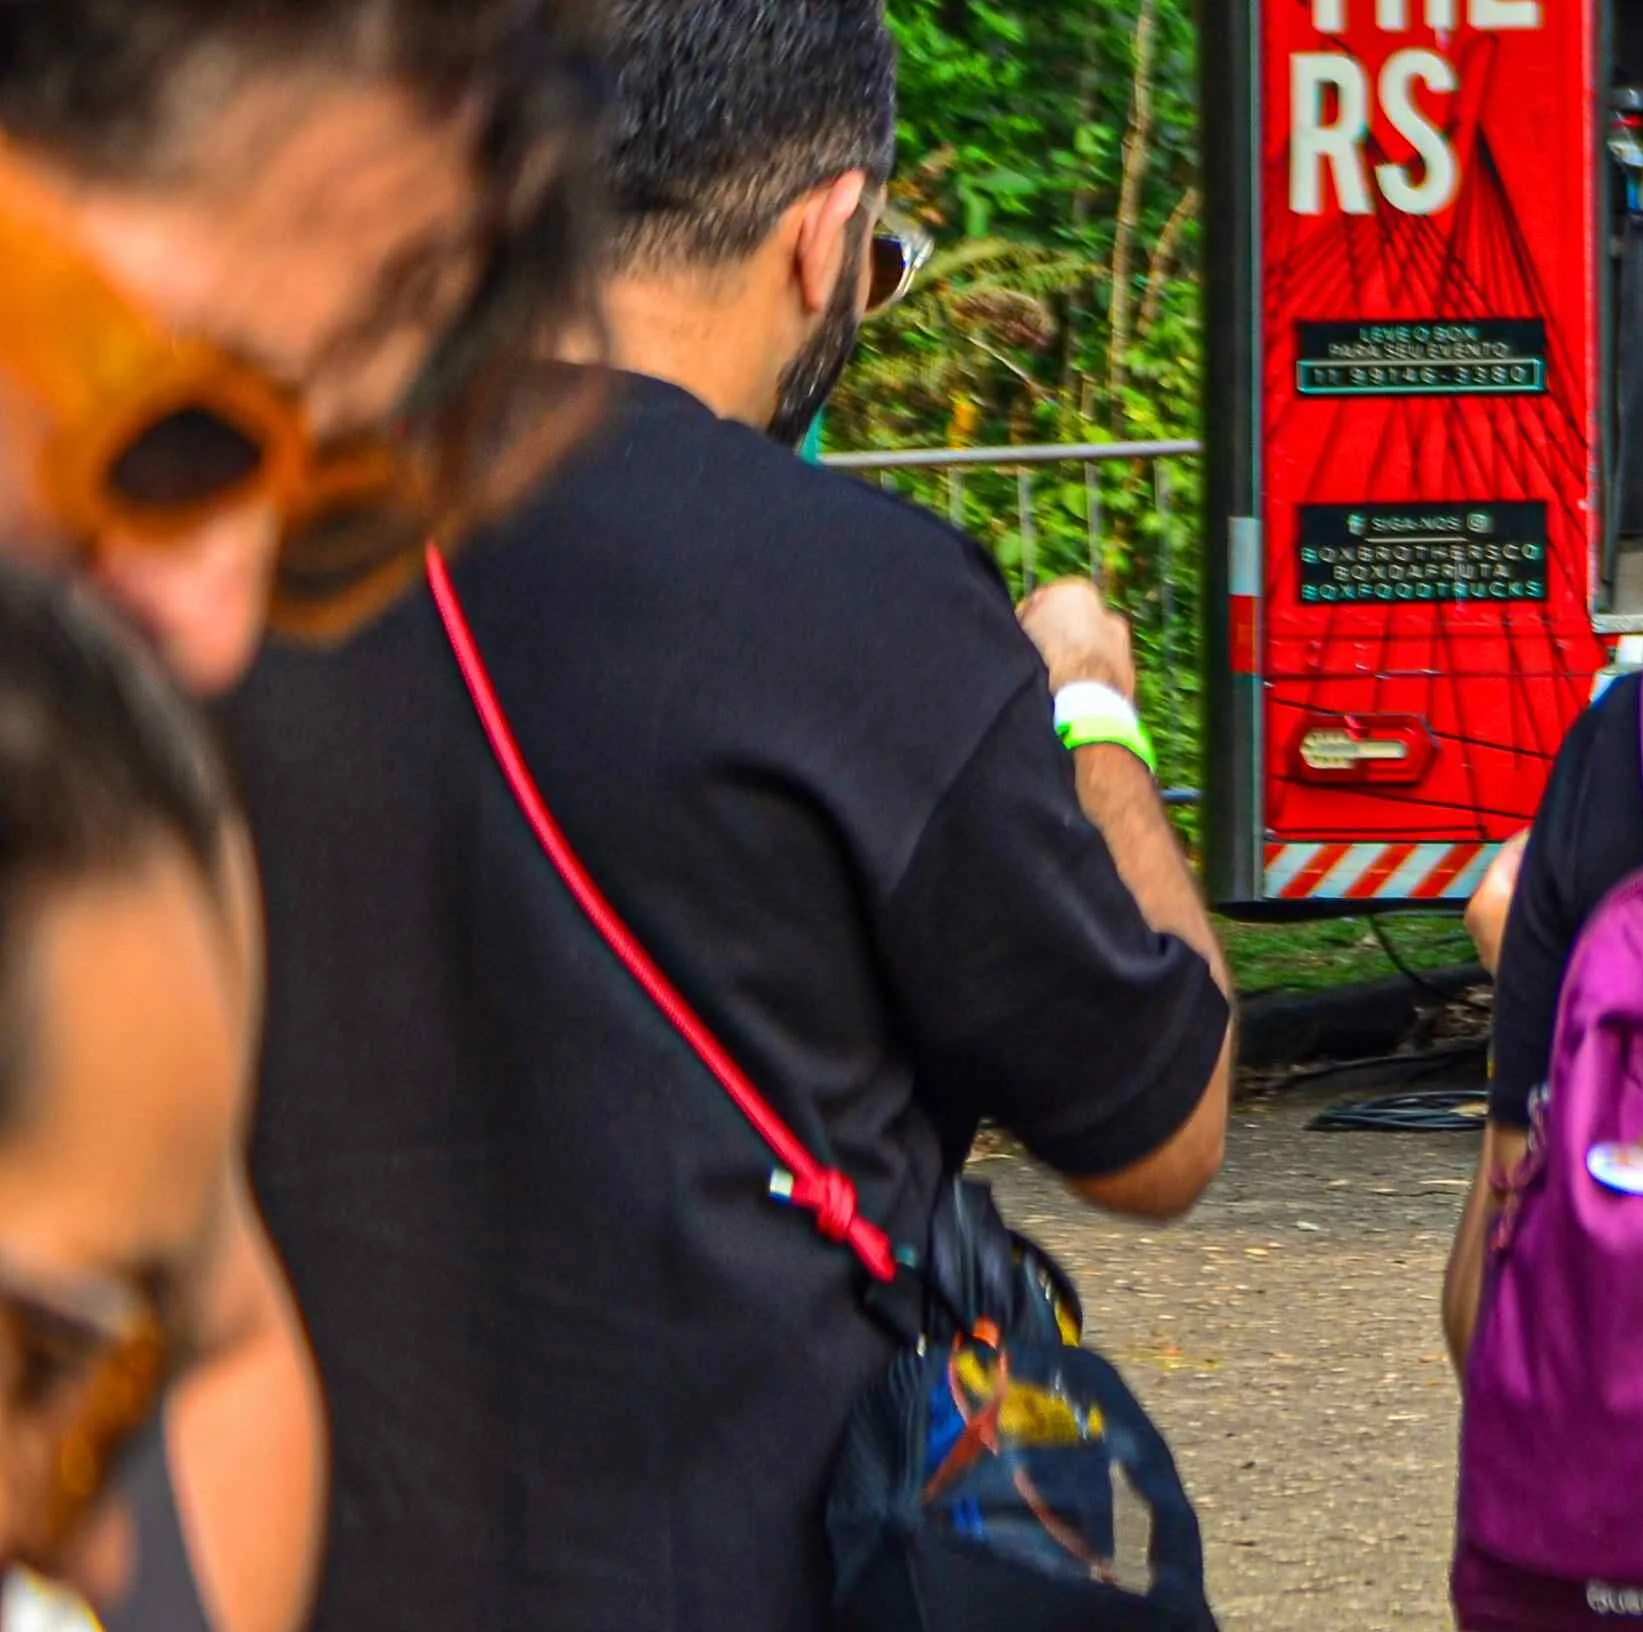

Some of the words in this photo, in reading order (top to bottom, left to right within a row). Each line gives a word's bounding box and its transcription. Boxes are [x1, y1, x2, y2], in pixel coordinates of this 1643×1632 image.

[1288, 46, 1461, 218] RS
[1359, 325, 1412, 344] LEVE
[1413, 325, 1431, 343] O
[1432, 325, 1480, 344] BOX
[1328, 342, 1383, 361] PARA
[1383, 342, 1425, 361] SEU
[1426, 340, 1511, 361] EVENTO
[1314, 366, 1339, 386] 11
[1300, 543, 1543, 565] BOXBROTHERSCO
[1300, 580, 1544, 602] BOXFOODTRUCKS
